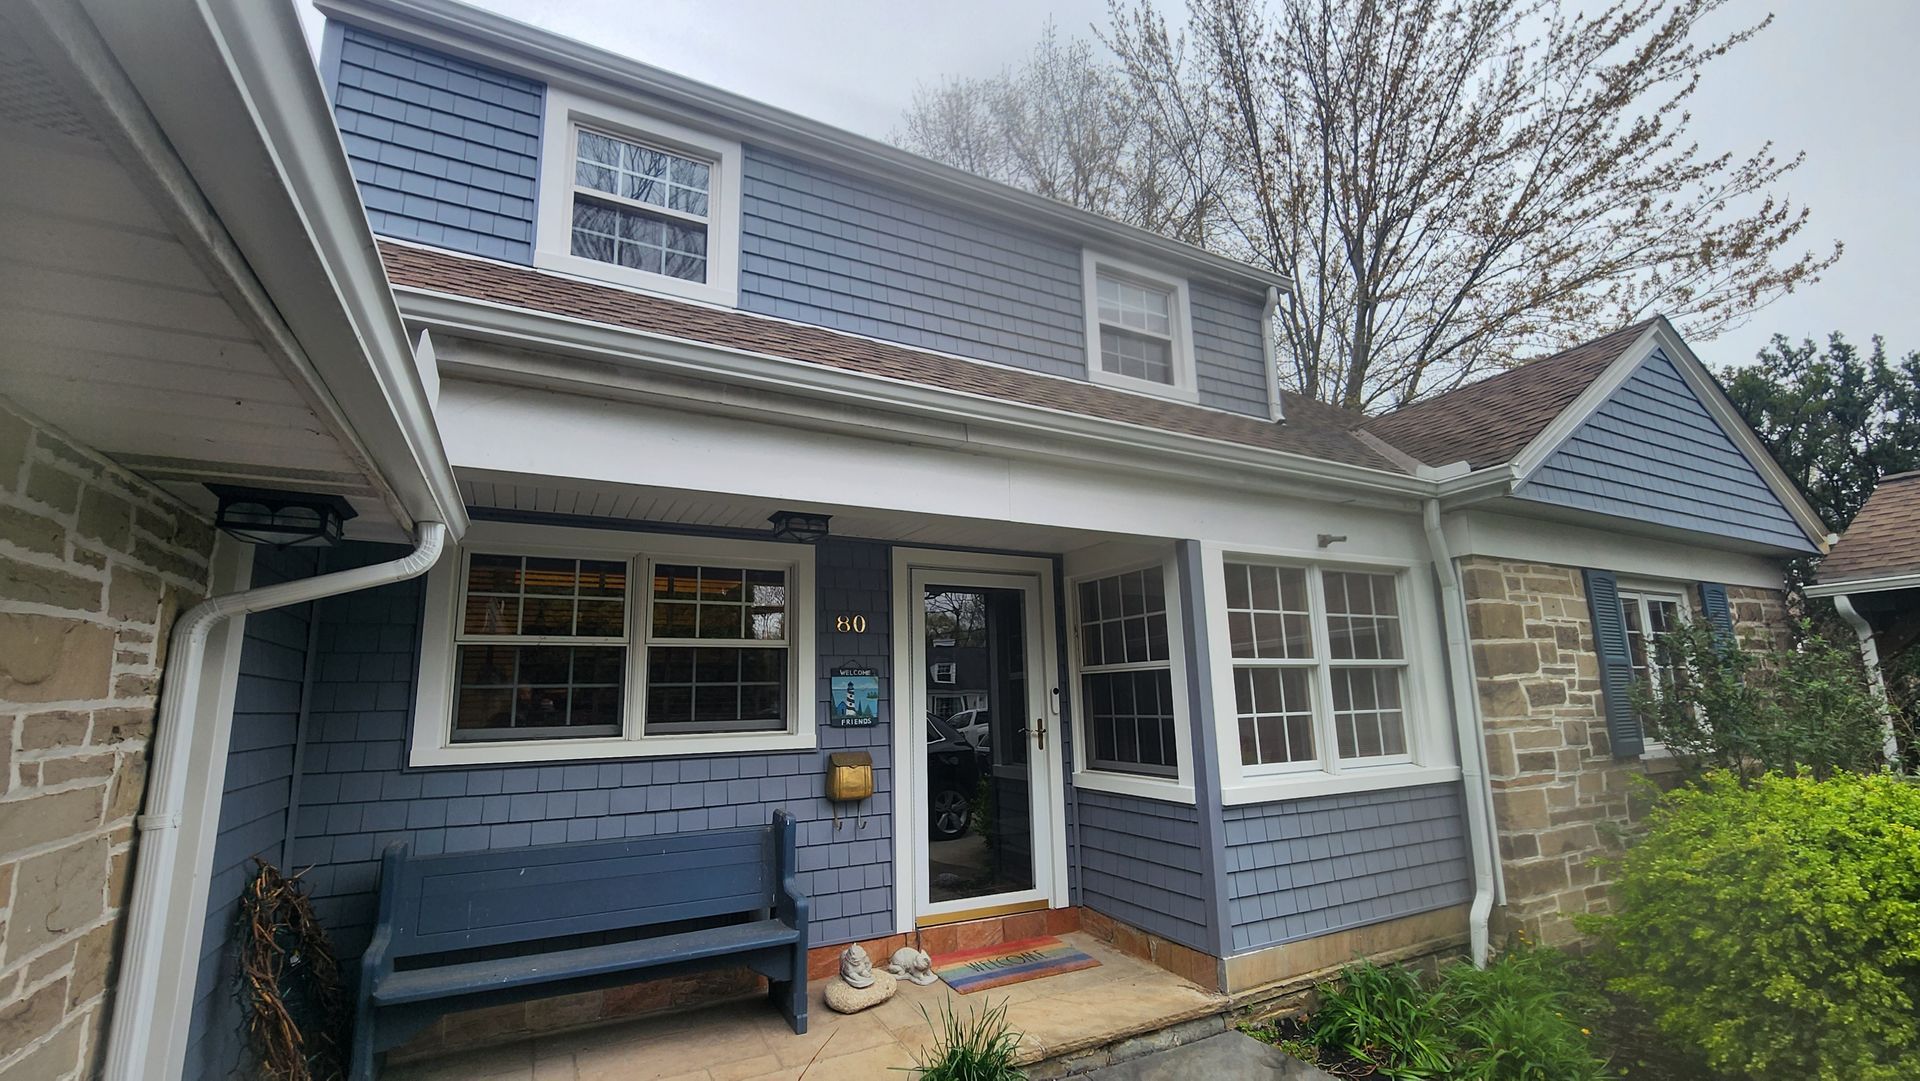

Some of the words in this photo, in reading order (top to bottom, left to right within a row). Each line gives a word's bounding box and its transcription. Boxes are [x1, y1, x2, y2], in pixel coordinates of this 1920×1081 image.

[836, 614, 866, 633] 80
[841, 717, 872, 726] FRIENDS
[964, 950, 1049, 972] WELCOME
